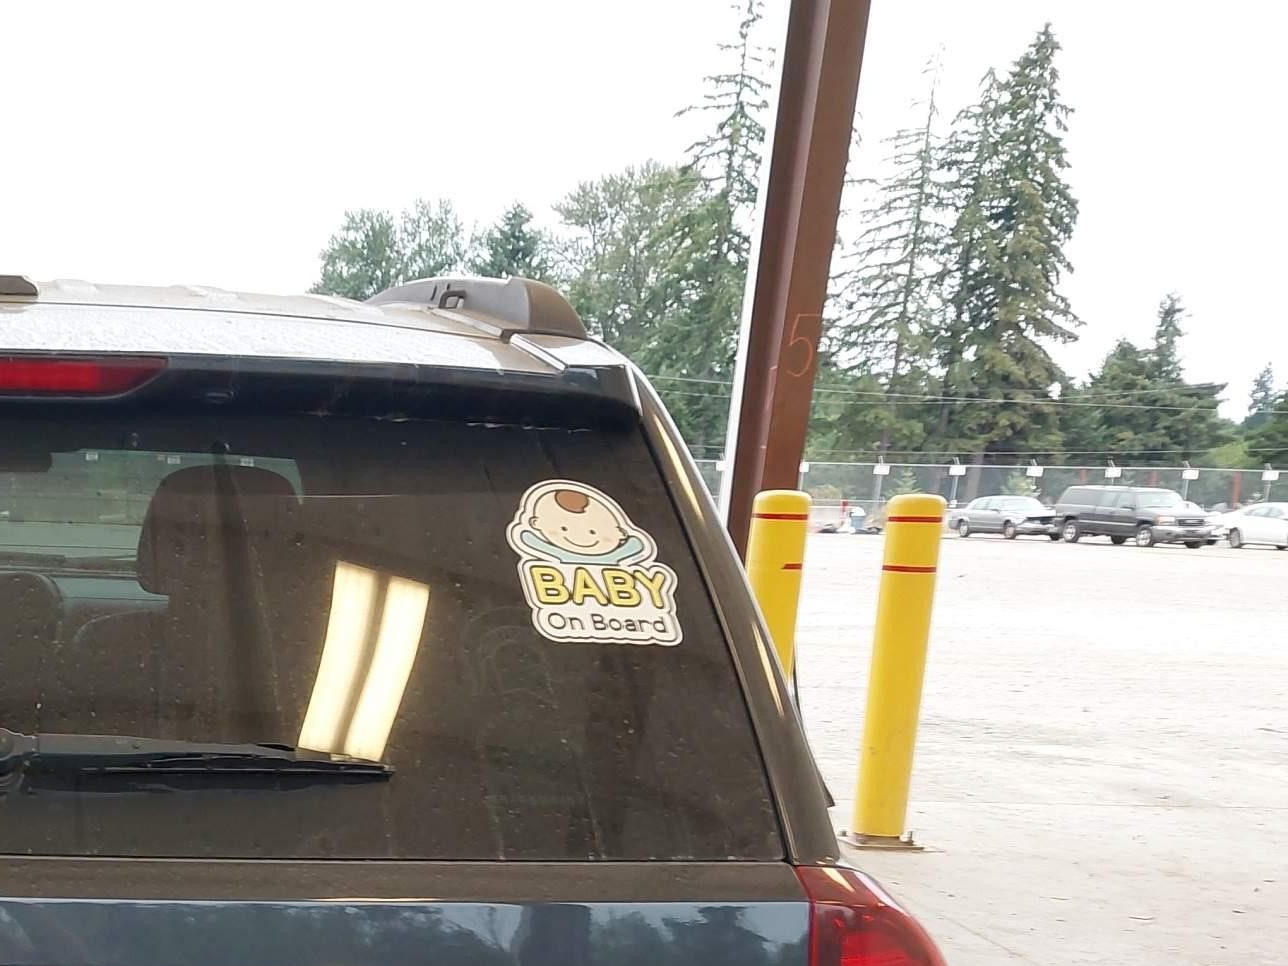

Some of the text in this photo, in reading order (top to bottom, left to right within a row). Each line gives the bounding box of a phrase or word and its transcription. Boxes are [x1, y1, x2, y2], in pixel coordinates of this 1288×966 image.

[529, 565, 666, 609] BABY
[547, 611, 668, 634] On Board
